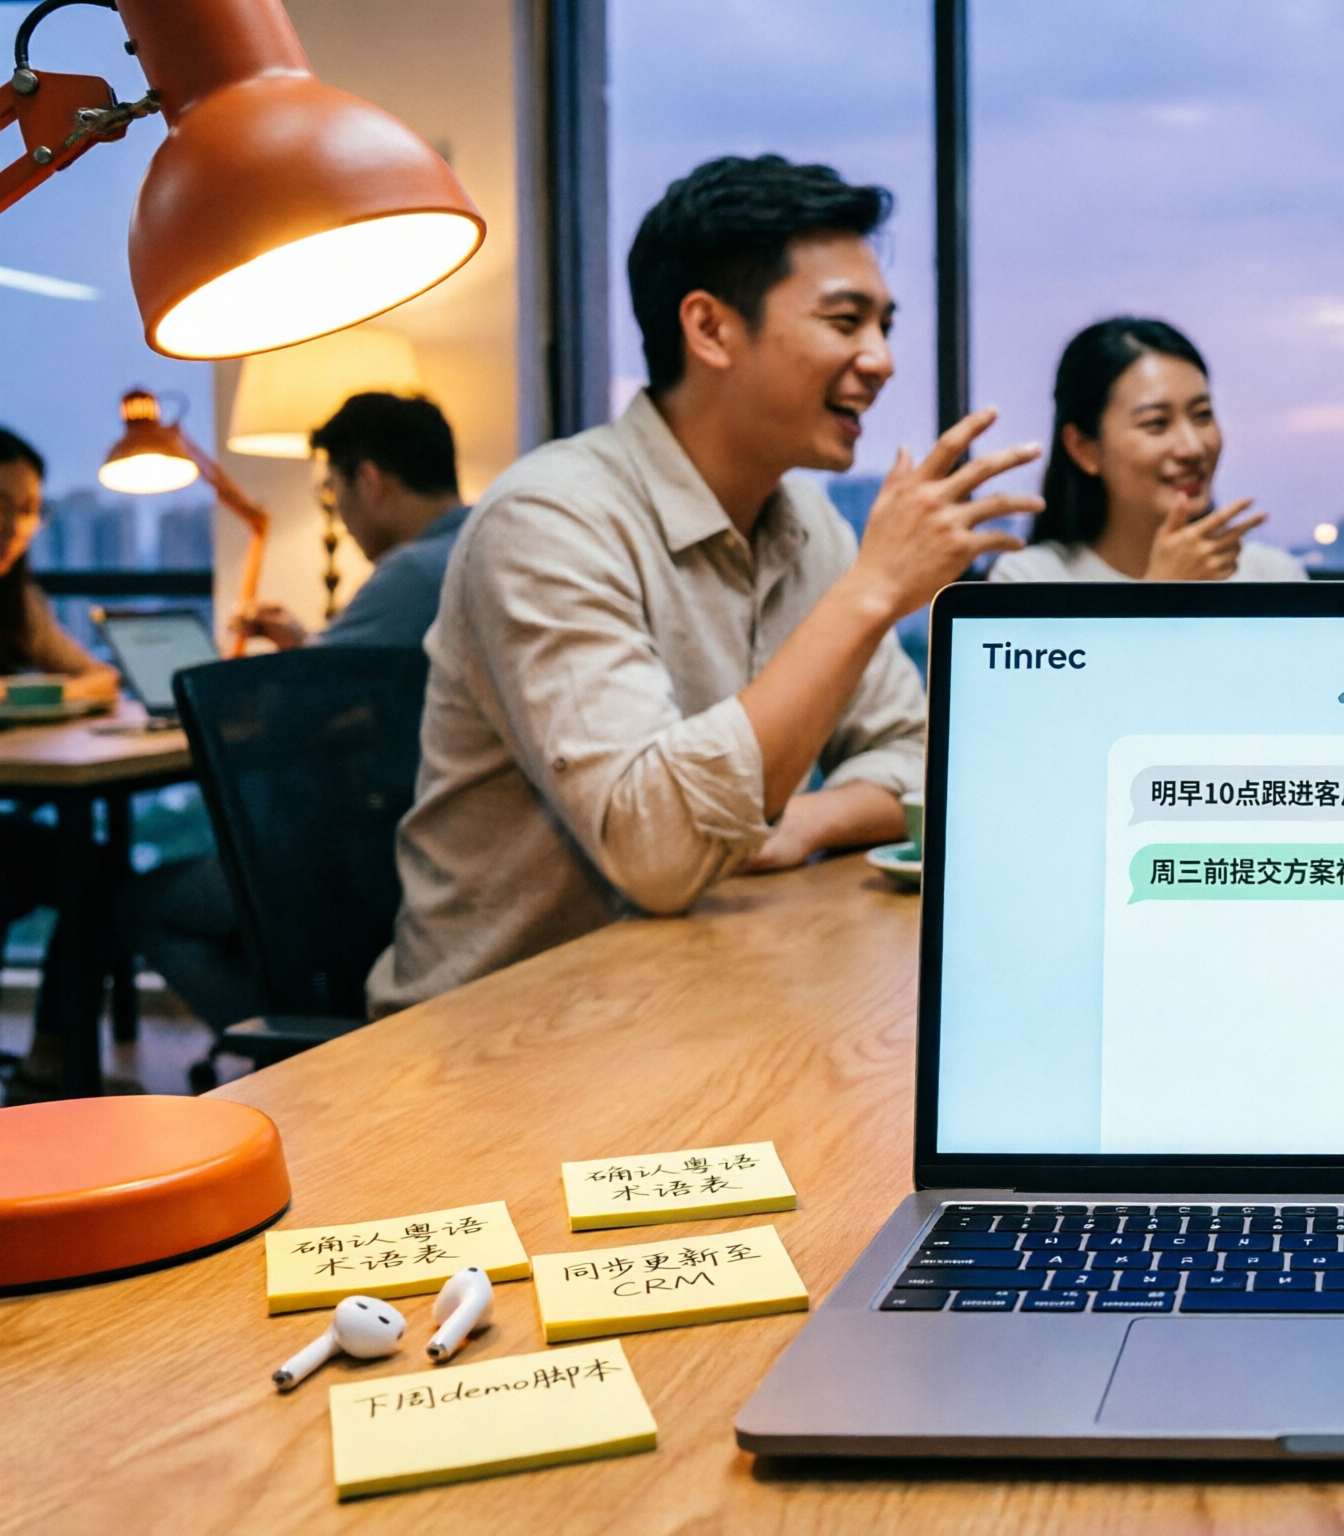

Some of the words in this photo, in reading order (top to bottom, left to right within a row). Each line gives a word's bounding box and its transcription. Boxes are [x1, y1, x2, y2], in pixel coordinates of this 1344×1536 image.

[981, 640, 1087, 670] Tinrec
[584, 1153, 760, 1183] 确认粤语
[612, 1174, 743, 1201] 术语表
[290, 1216, 489, 1255] 确认粤语
[313, 1244, 461, 1276] 术语表
[563, 1243, 762, 1282] 同步更新至
[613, 1271, 716, 1297] CRM
[353, 1358, 622, 1418] 下周demo脚本
